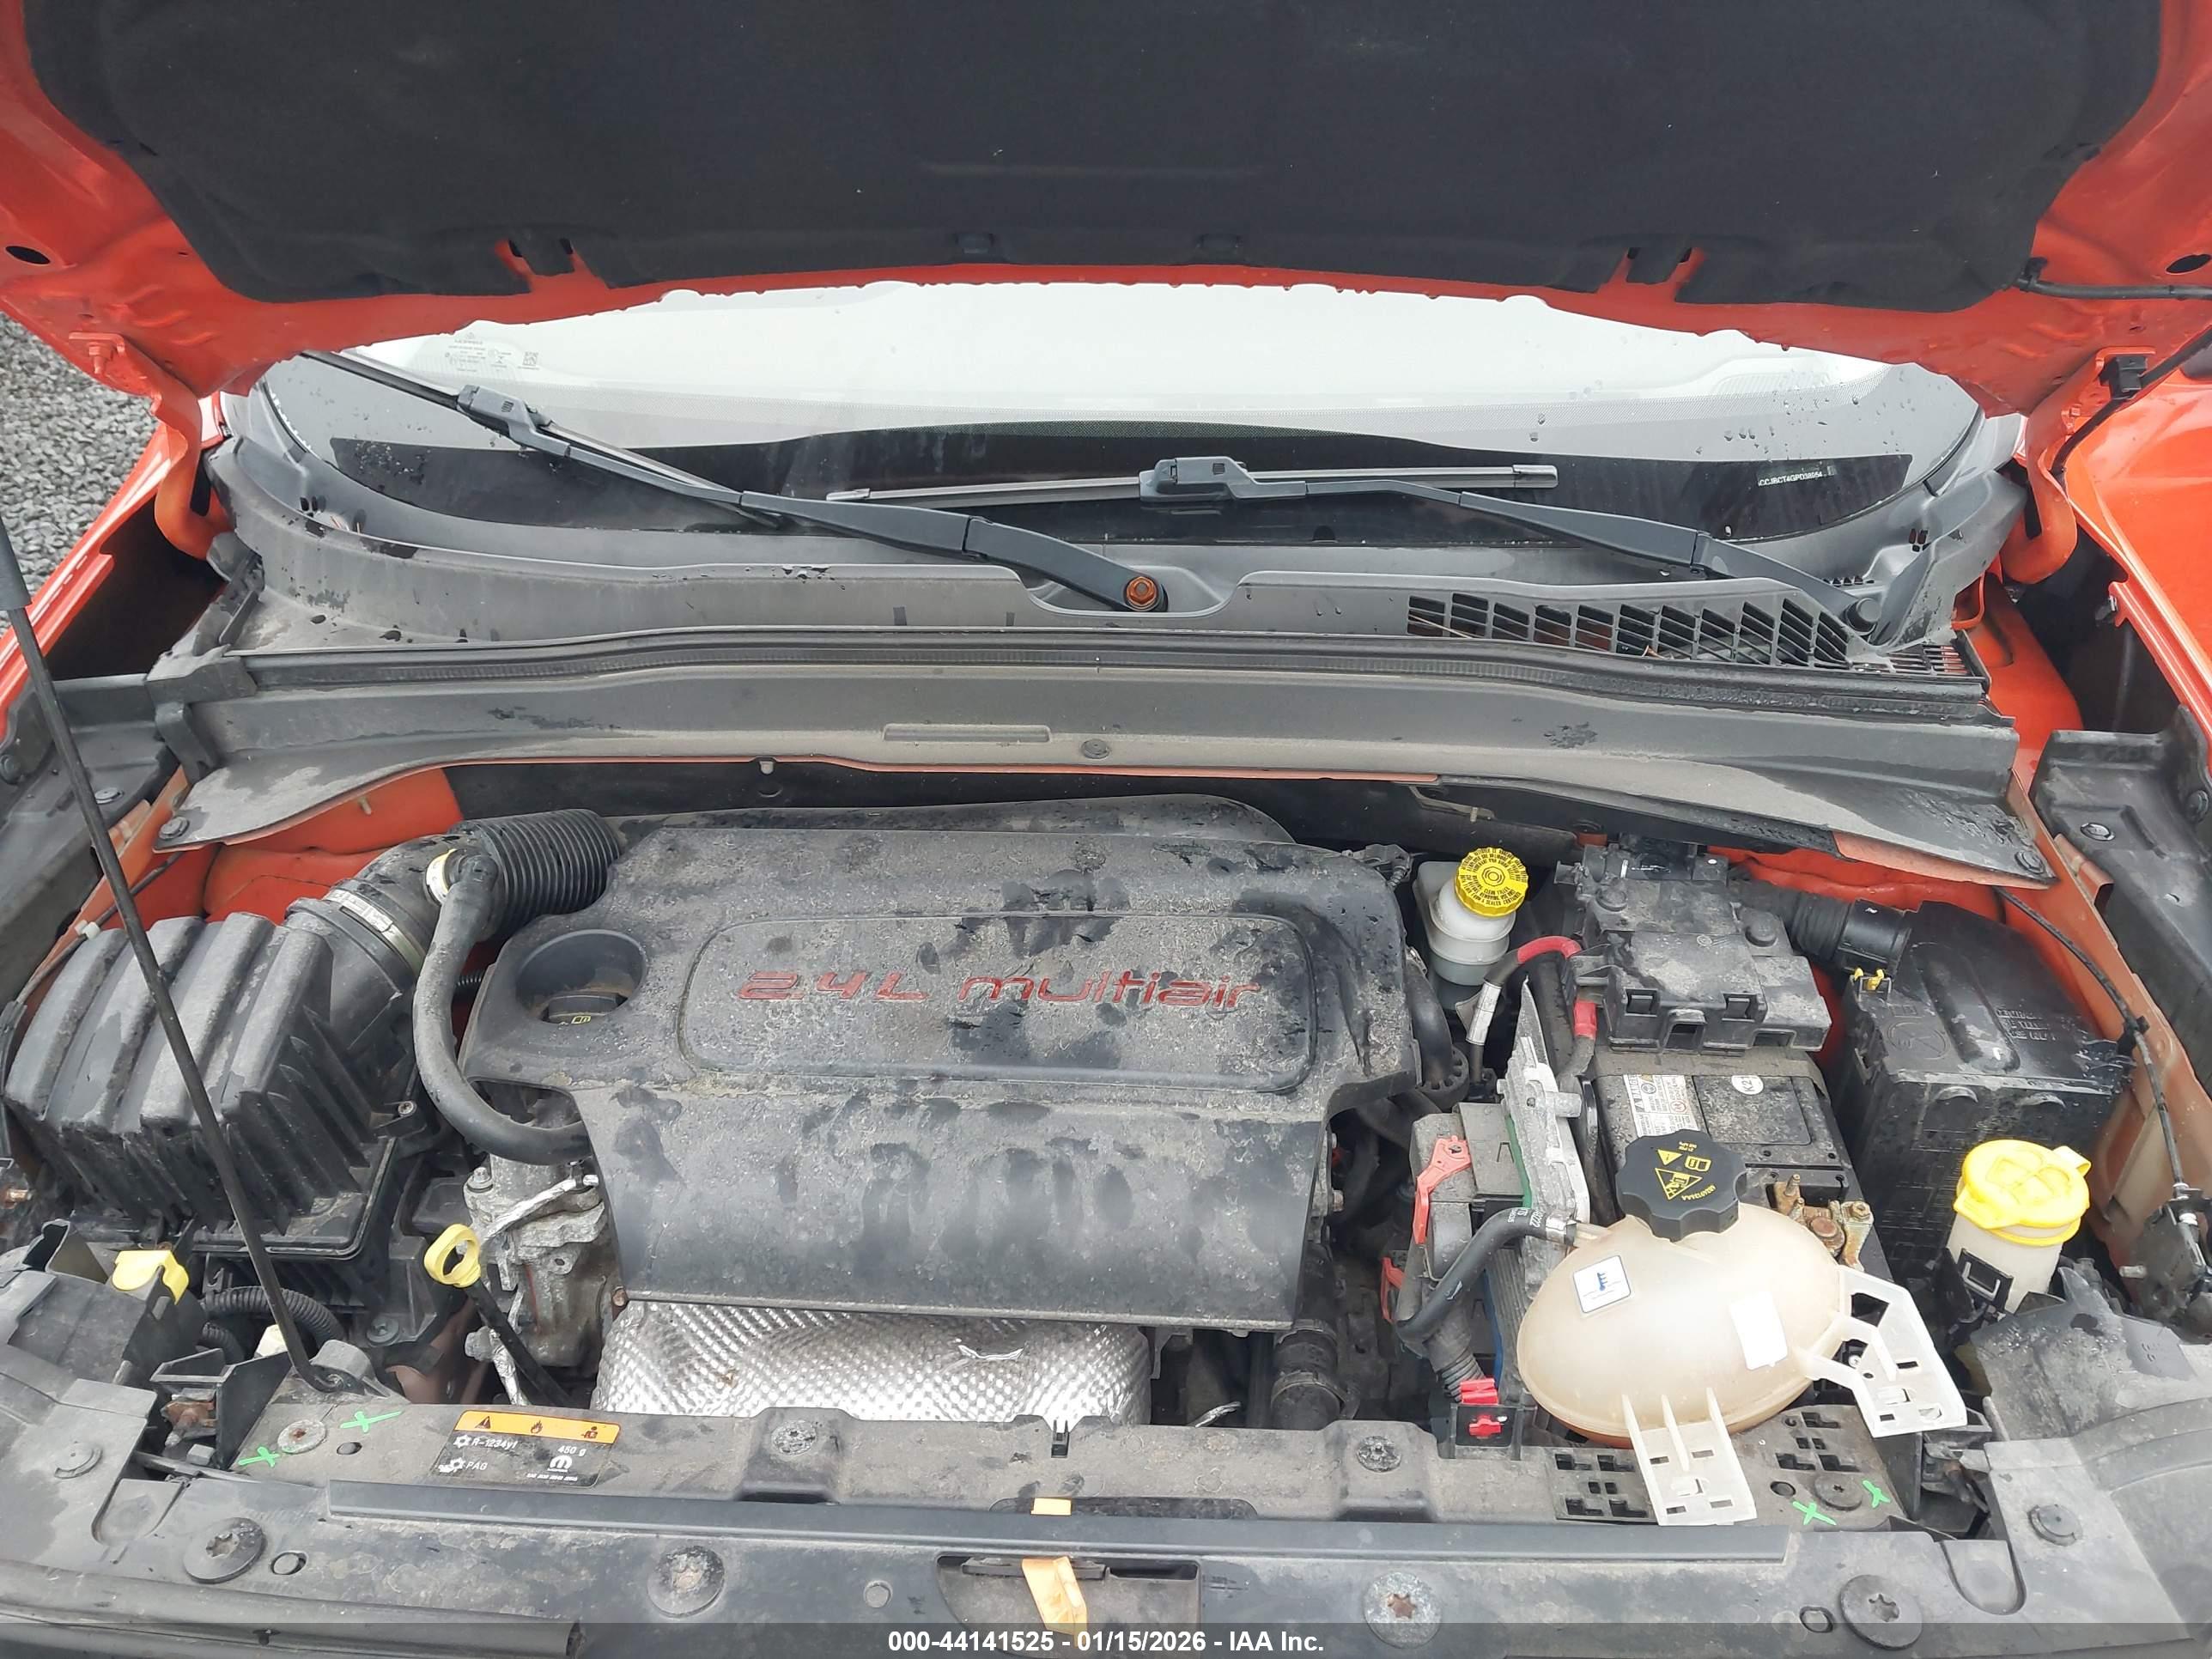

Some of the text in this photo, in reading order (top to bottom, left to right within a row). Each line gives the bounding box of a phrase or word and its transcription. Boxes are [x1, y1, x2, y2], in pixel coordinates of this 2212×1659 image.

[958, 969, 1261, 1008] multiair
[1629, 1074, 1642, 1100] DANGE
[557, 1444, 587, 1457] 450 g
[465, 1460, 489, 1471] PAG
